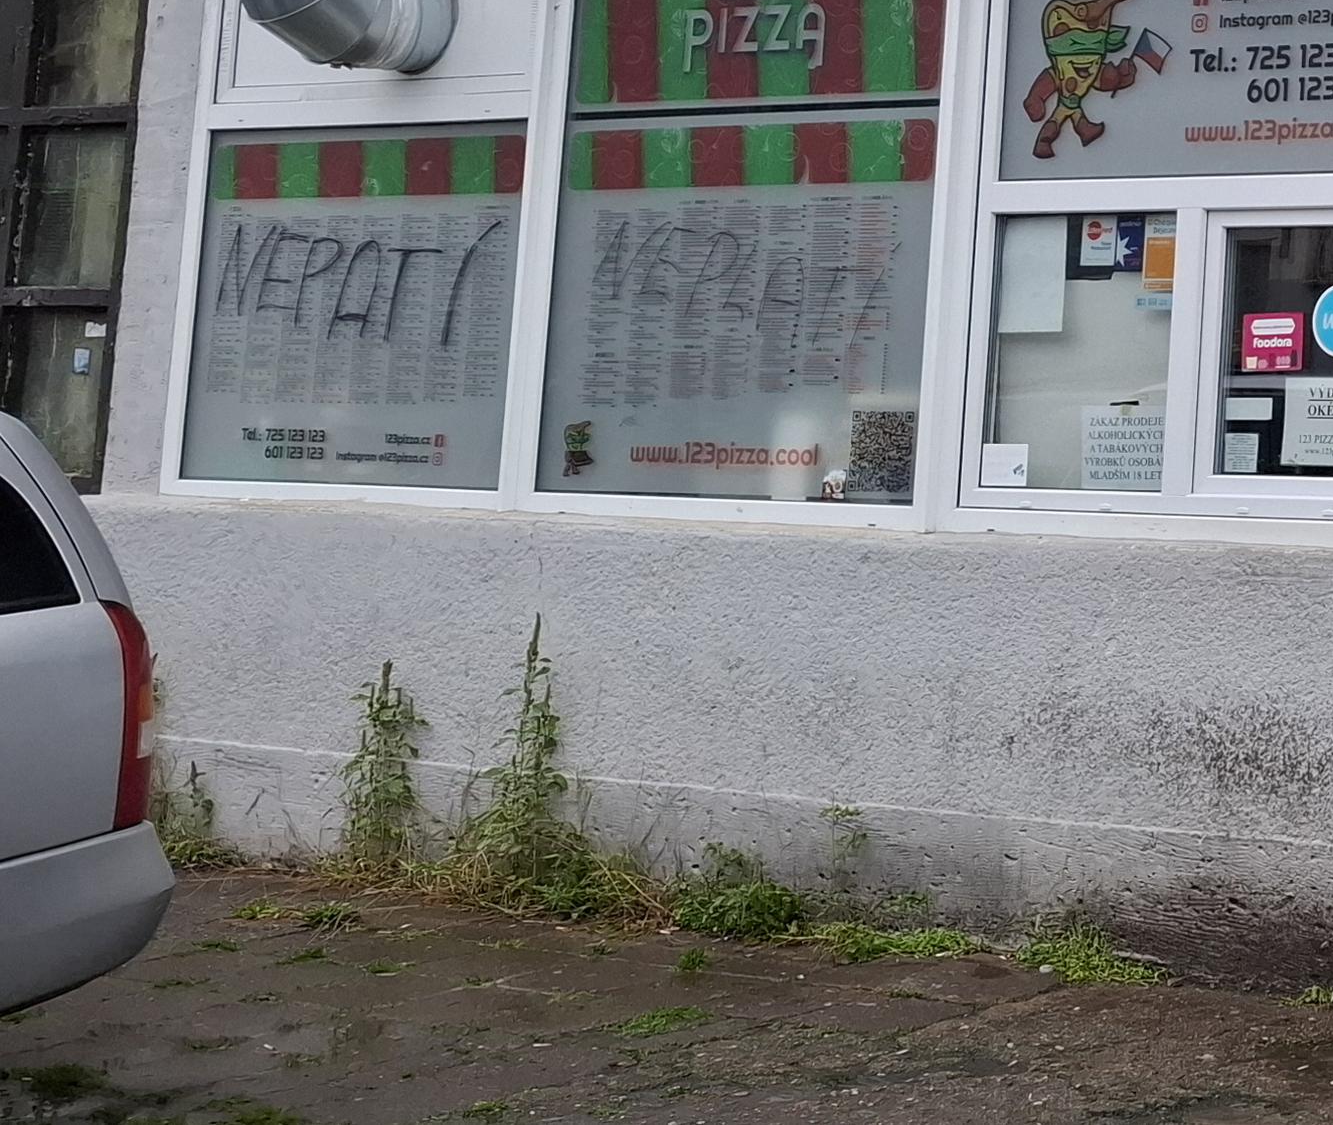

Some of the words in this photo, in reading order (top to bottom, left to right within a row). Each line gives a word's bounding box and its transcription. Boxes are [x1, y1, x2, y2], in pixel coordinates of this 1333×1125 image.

[1219, 12, 1293, 30] Instagram
[682, 2, 827, 73] PIZZA
[1190, 47, 1237, 73] Tel.:
[1246, 45, 1291, 70] 725
[1247, 77, 1289, 103] 601
[1253, 336, 1292, 348] foodora
[1090, 416, 1120, 426] ZÁKAZ
[1122, 416, 1166, 426] PRODEJE
[242, 428, 261, 441] Tel.:
[265, 428, 284, 442] 725
[288, 429, 304, 442] 123
[308, 429, 325, 442] 123
[385, 434, 431, 445] 123pizza.cz
[1299, 435, 1311, 444] 123
[264, 445, 283, 459] 601
[286, 446, 303, 459] 123
[307, 447, 324, 459] 123
[335, 451, 377, 463] Instagram
[630, 442, 818, 470] www.123pizza.cool
[1090, 444, 1096, 453] A
[1084, 455, 1127, 466] VÝROBKŮ
[1128, 455, 1164, 466] OSOBÁ
[1134, 471, 1143, 480] 18
